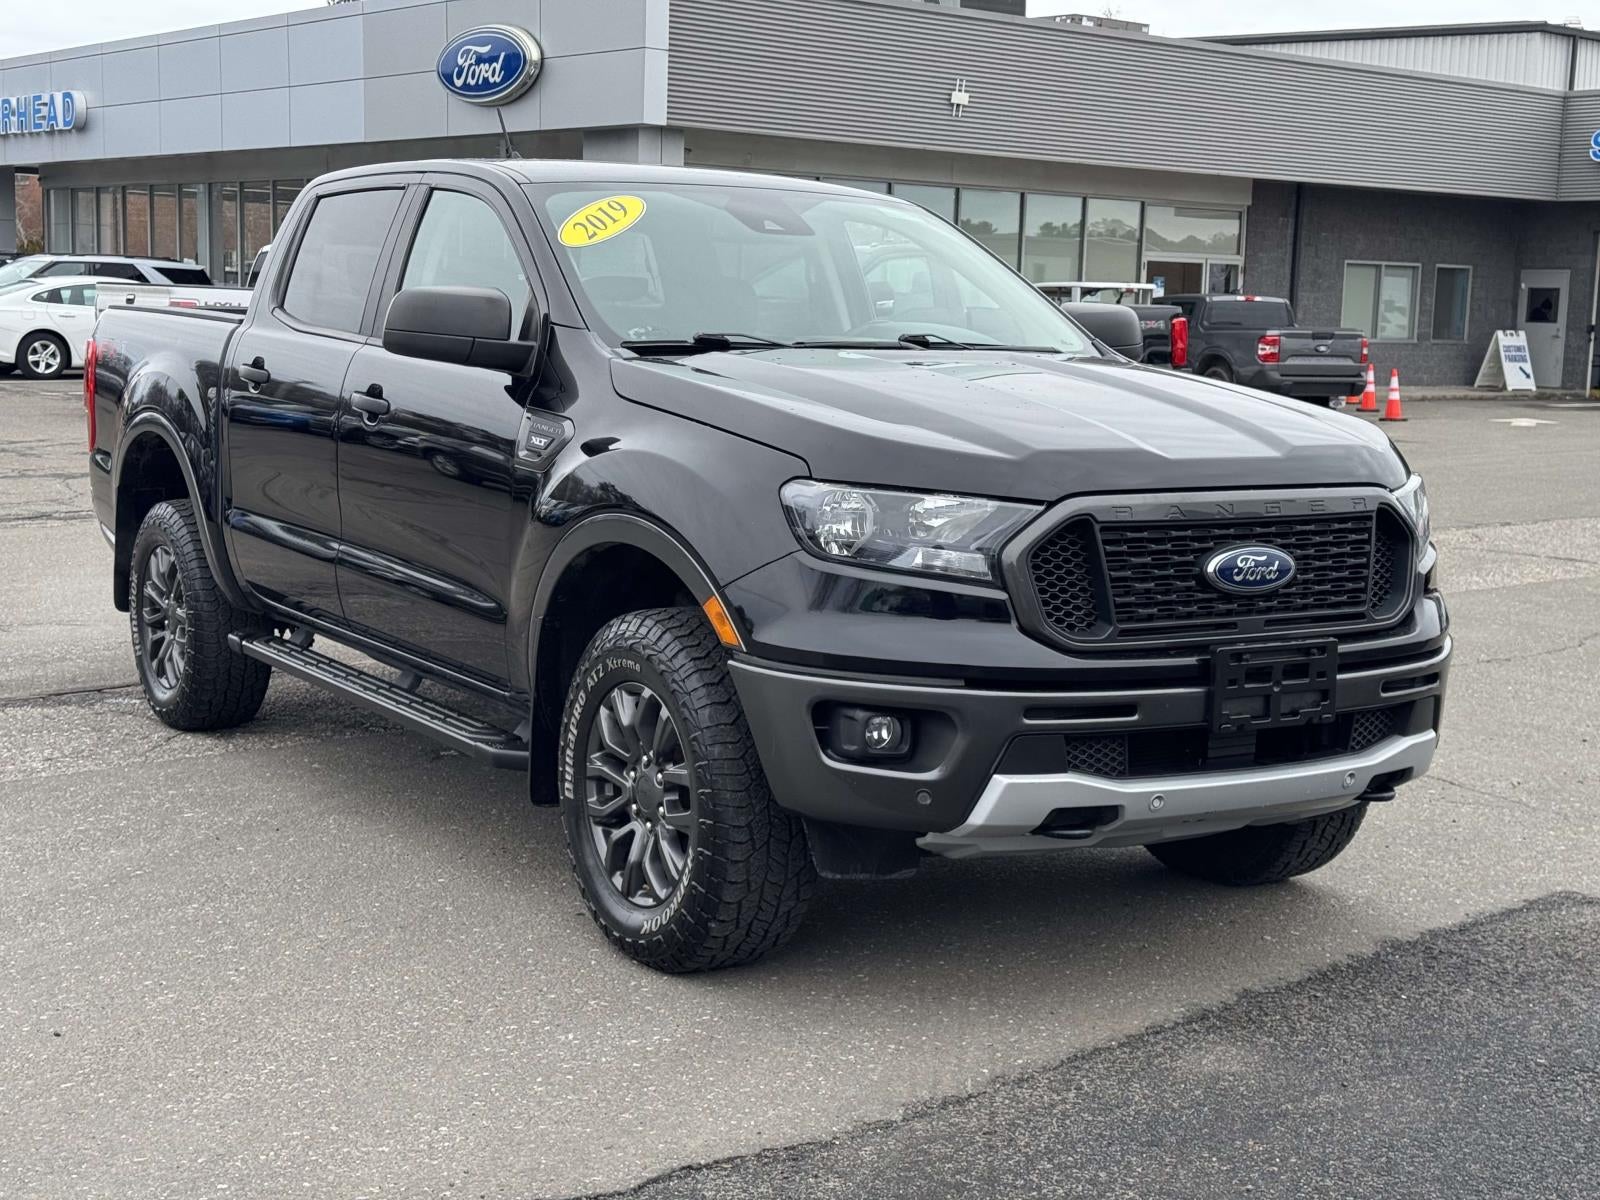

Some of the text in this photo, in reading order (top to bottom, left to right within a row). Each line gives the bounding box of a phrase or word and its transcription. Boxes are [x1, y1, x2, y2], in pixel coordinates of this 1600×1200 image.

[453, 44, 505, 88] Ford
[572, 200, 628, 241] 2019
[530, 435, 549, 447] XLT
[1111, 497, 1369, 520] RANGER
[1232, 554, 1280, 582] Ford
[606, 657, 641, 673] Xtreme
